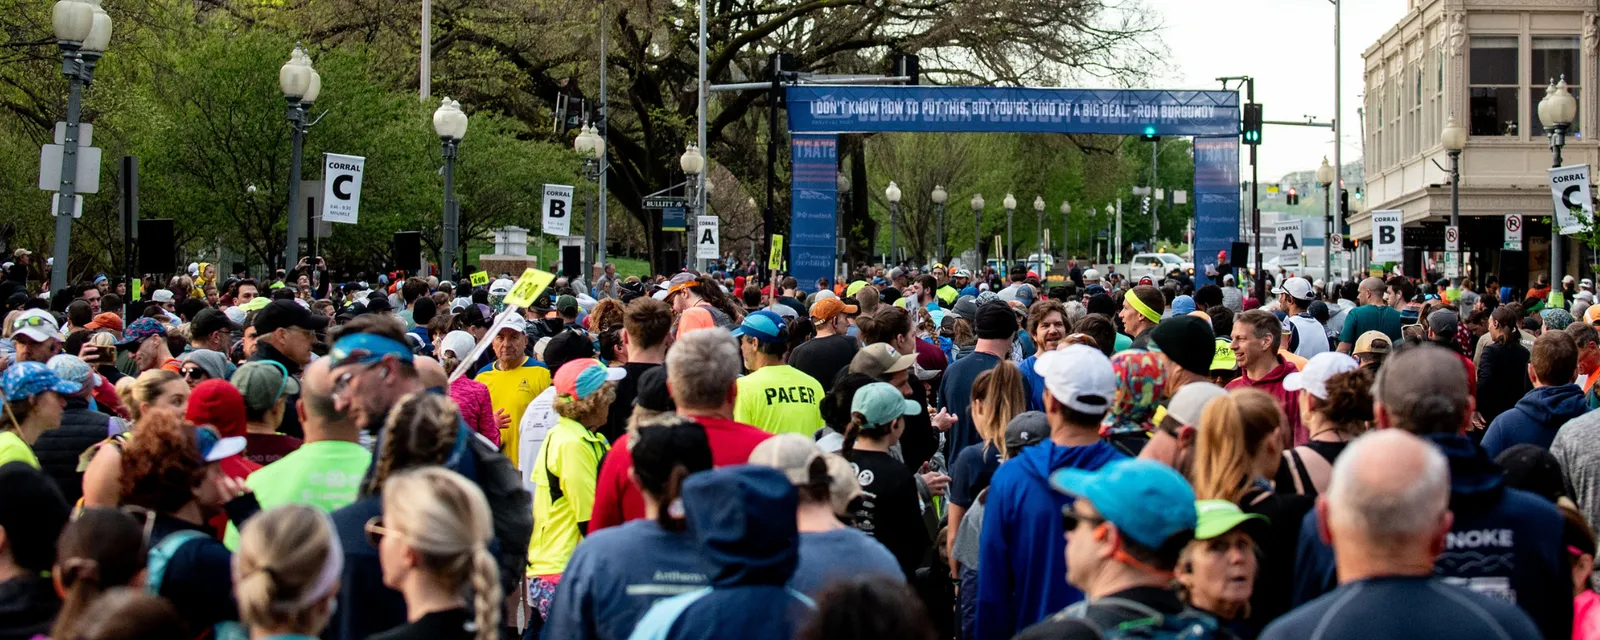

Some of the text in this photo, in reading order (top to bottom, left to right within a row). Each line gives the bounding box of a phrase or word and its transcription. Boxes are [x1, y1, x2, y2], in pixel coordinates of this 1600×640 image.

[810, 101, 1215, 118] I DON'T KNOW HOW TO PUT THIS, BUT YOU'RE KIND OF A BIG DEAL. -RON BURGUNDY
[329, 162, 361, 172] CORRAL
[332, 174, 354, 201] C
[1552, 173, 1585, 184] CORRAL
[546, 190, 571, 198] CORRAL
[1561, 184, 1583, 211] C
[549, 199, 566, 218] B
[700, 228, 715, 245] A
[1281, 233, 1299, 250] A
[1379, 225, 1396, 245] B
[764, 386, 816, 405] PACER
[1446, 528, 1514, 549] NOKE
